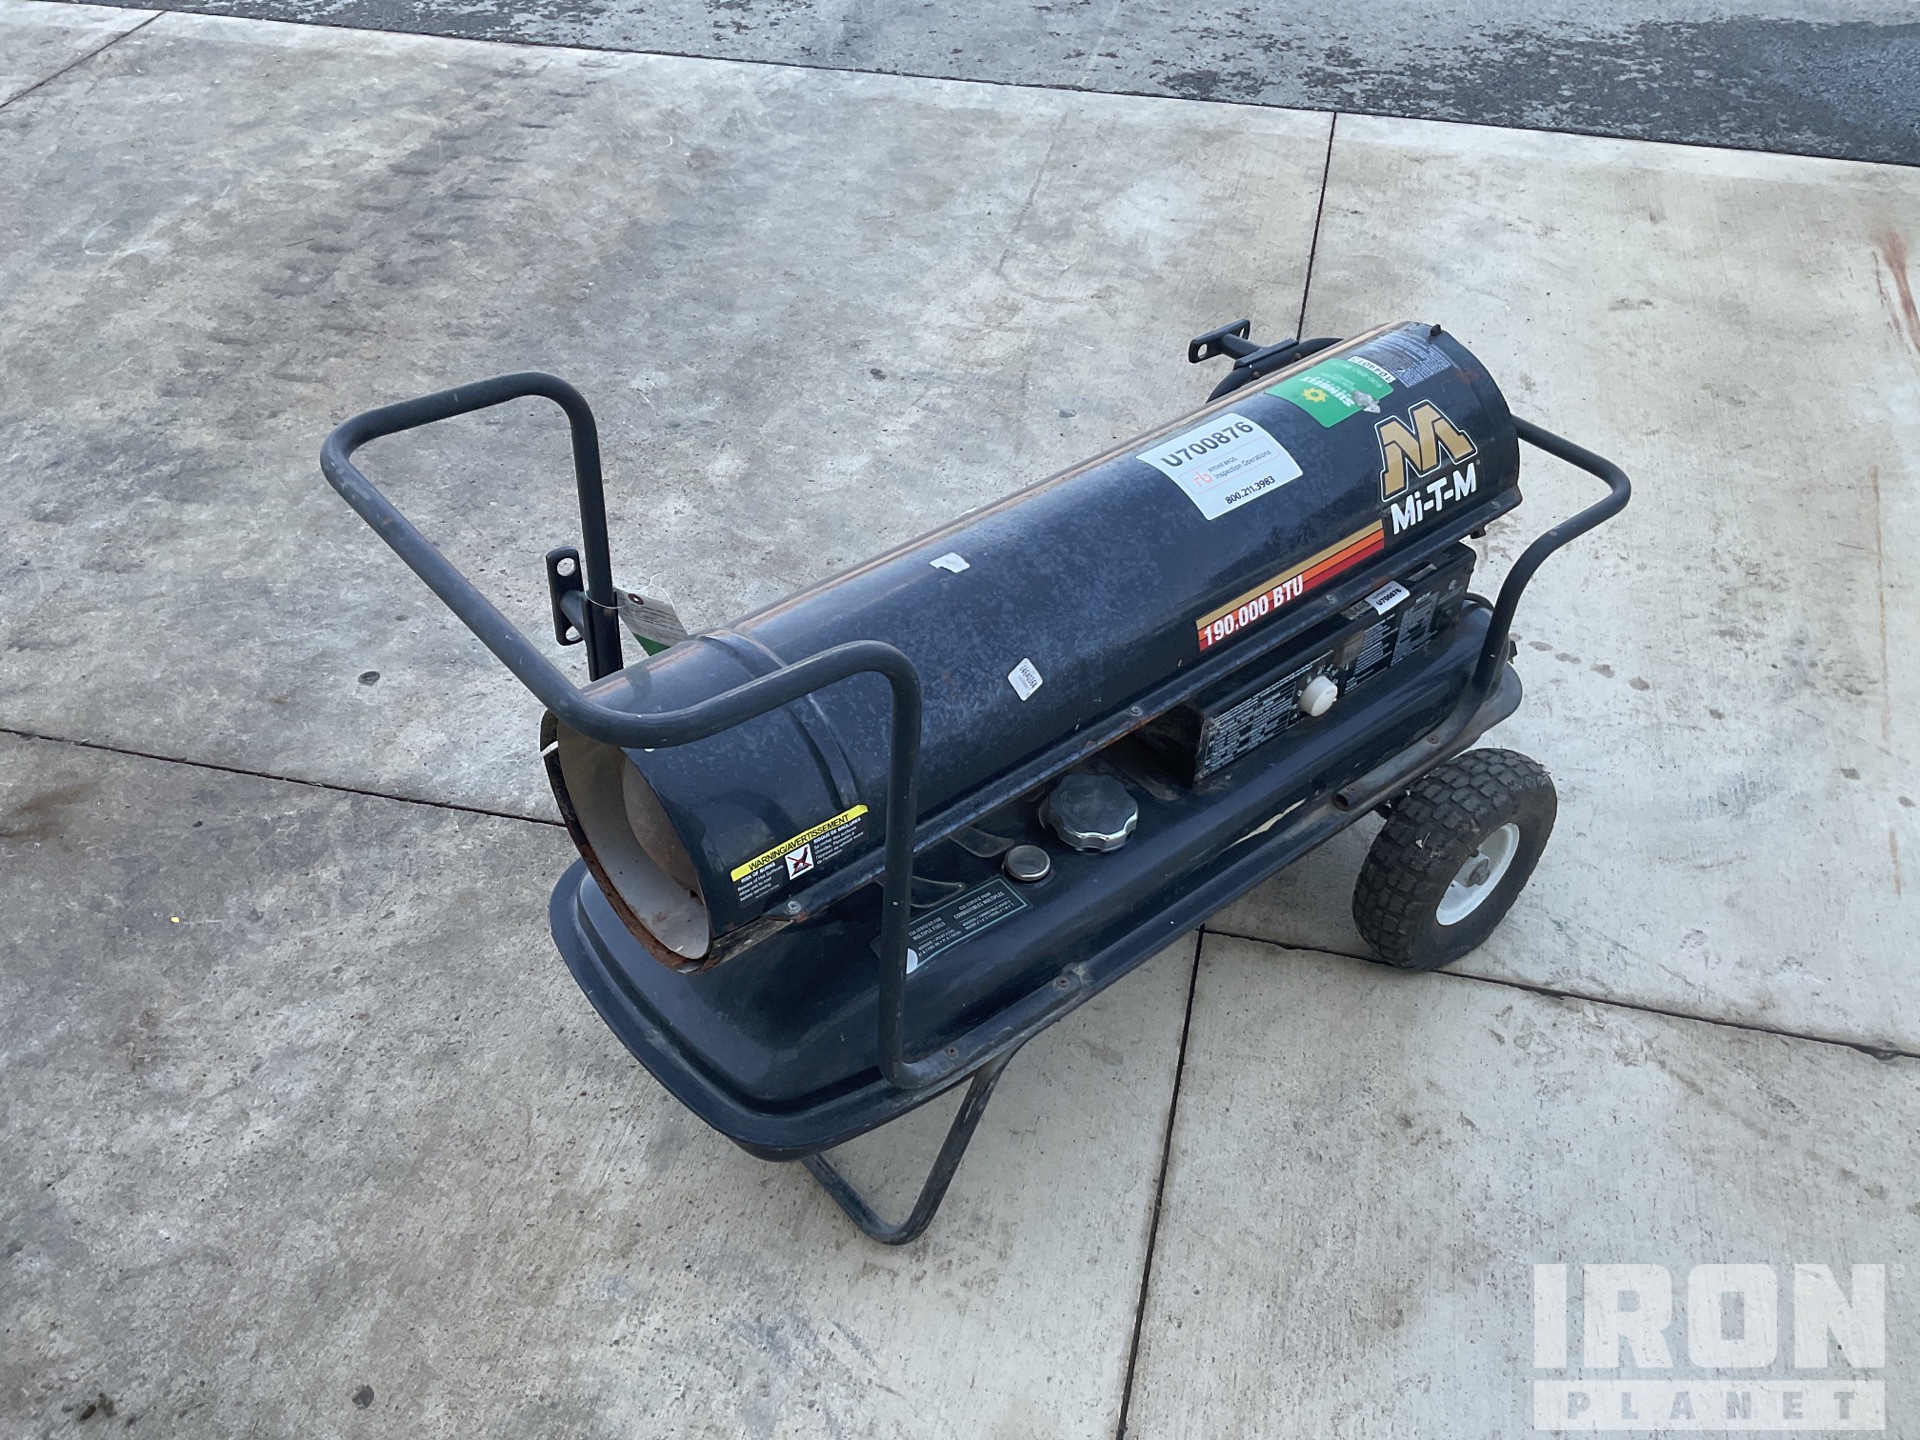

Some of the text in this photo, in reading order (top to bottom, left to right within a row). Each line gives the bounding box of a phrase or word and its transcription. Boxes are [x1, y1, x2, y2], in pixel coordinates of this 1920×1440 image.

[1160, 422, 1254, 467] U700876
[1214, 450, 1272, 480] Inspection Operations
[1225, 476, 1276, 504] 800.211.3983
[1390, 463, 1477, 534] Mi-T-M
[1273, 574, 1304, 608] BTU
[748, 814, 849, 870] WARNING/AVERTISSEMENT
